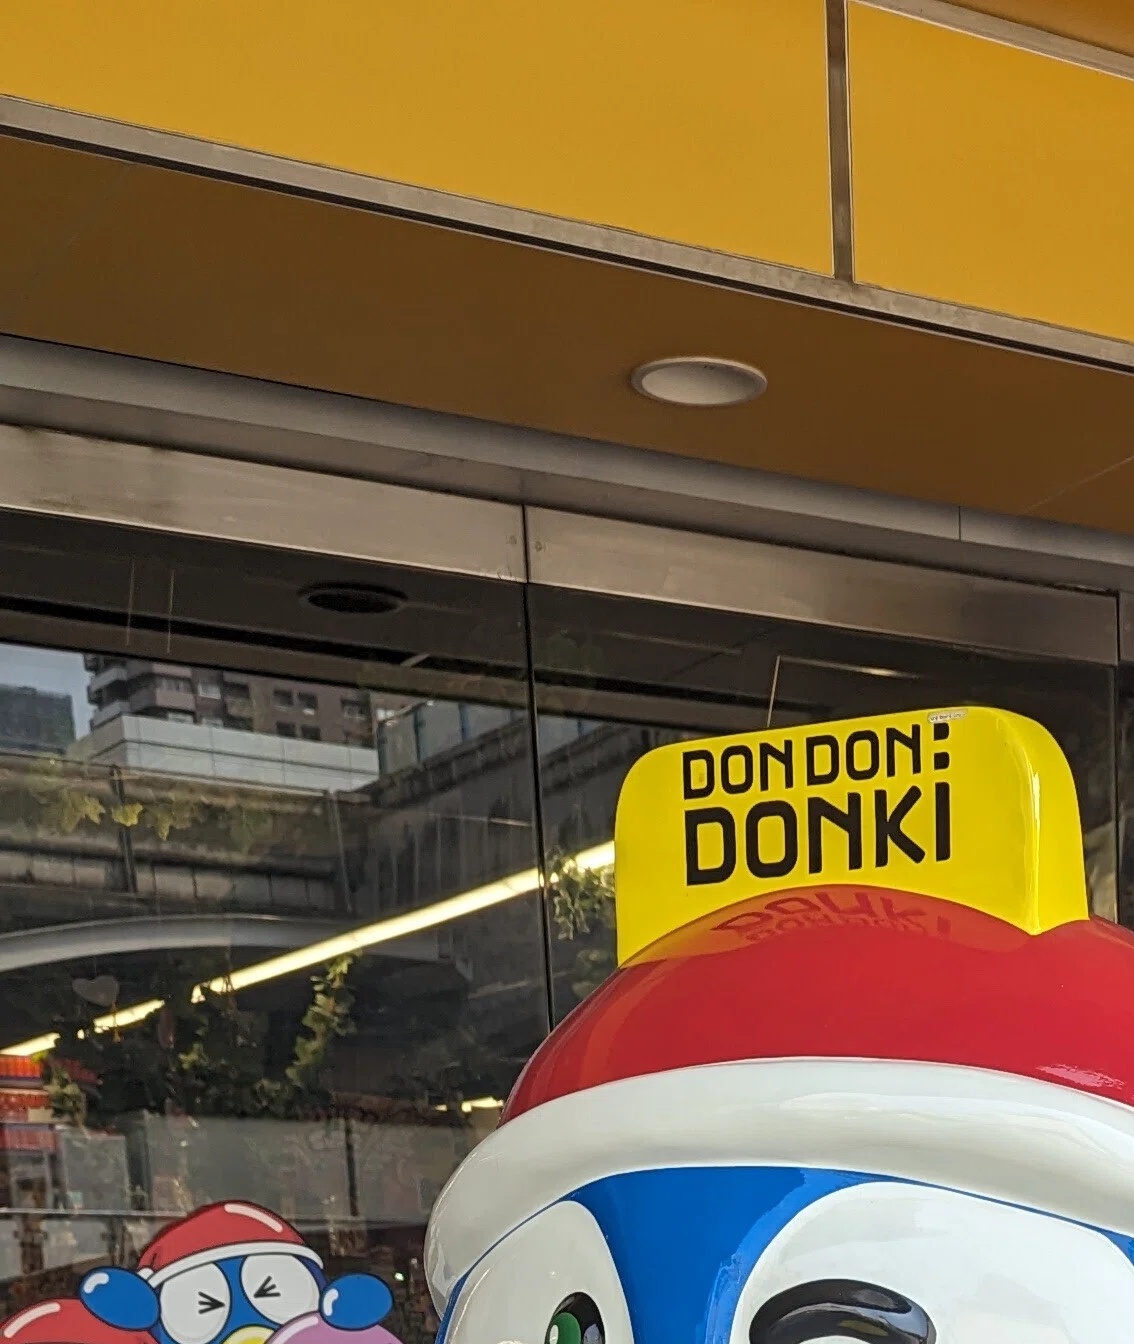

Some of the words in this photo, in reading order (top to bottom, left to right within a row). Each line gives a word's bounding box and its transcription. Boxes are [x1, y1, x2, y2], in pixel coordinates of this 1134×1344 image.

[682, 740, 794, 800] DON
[806, 723, 921, 787] DON
[684, 781, 952, 887] DONKI
